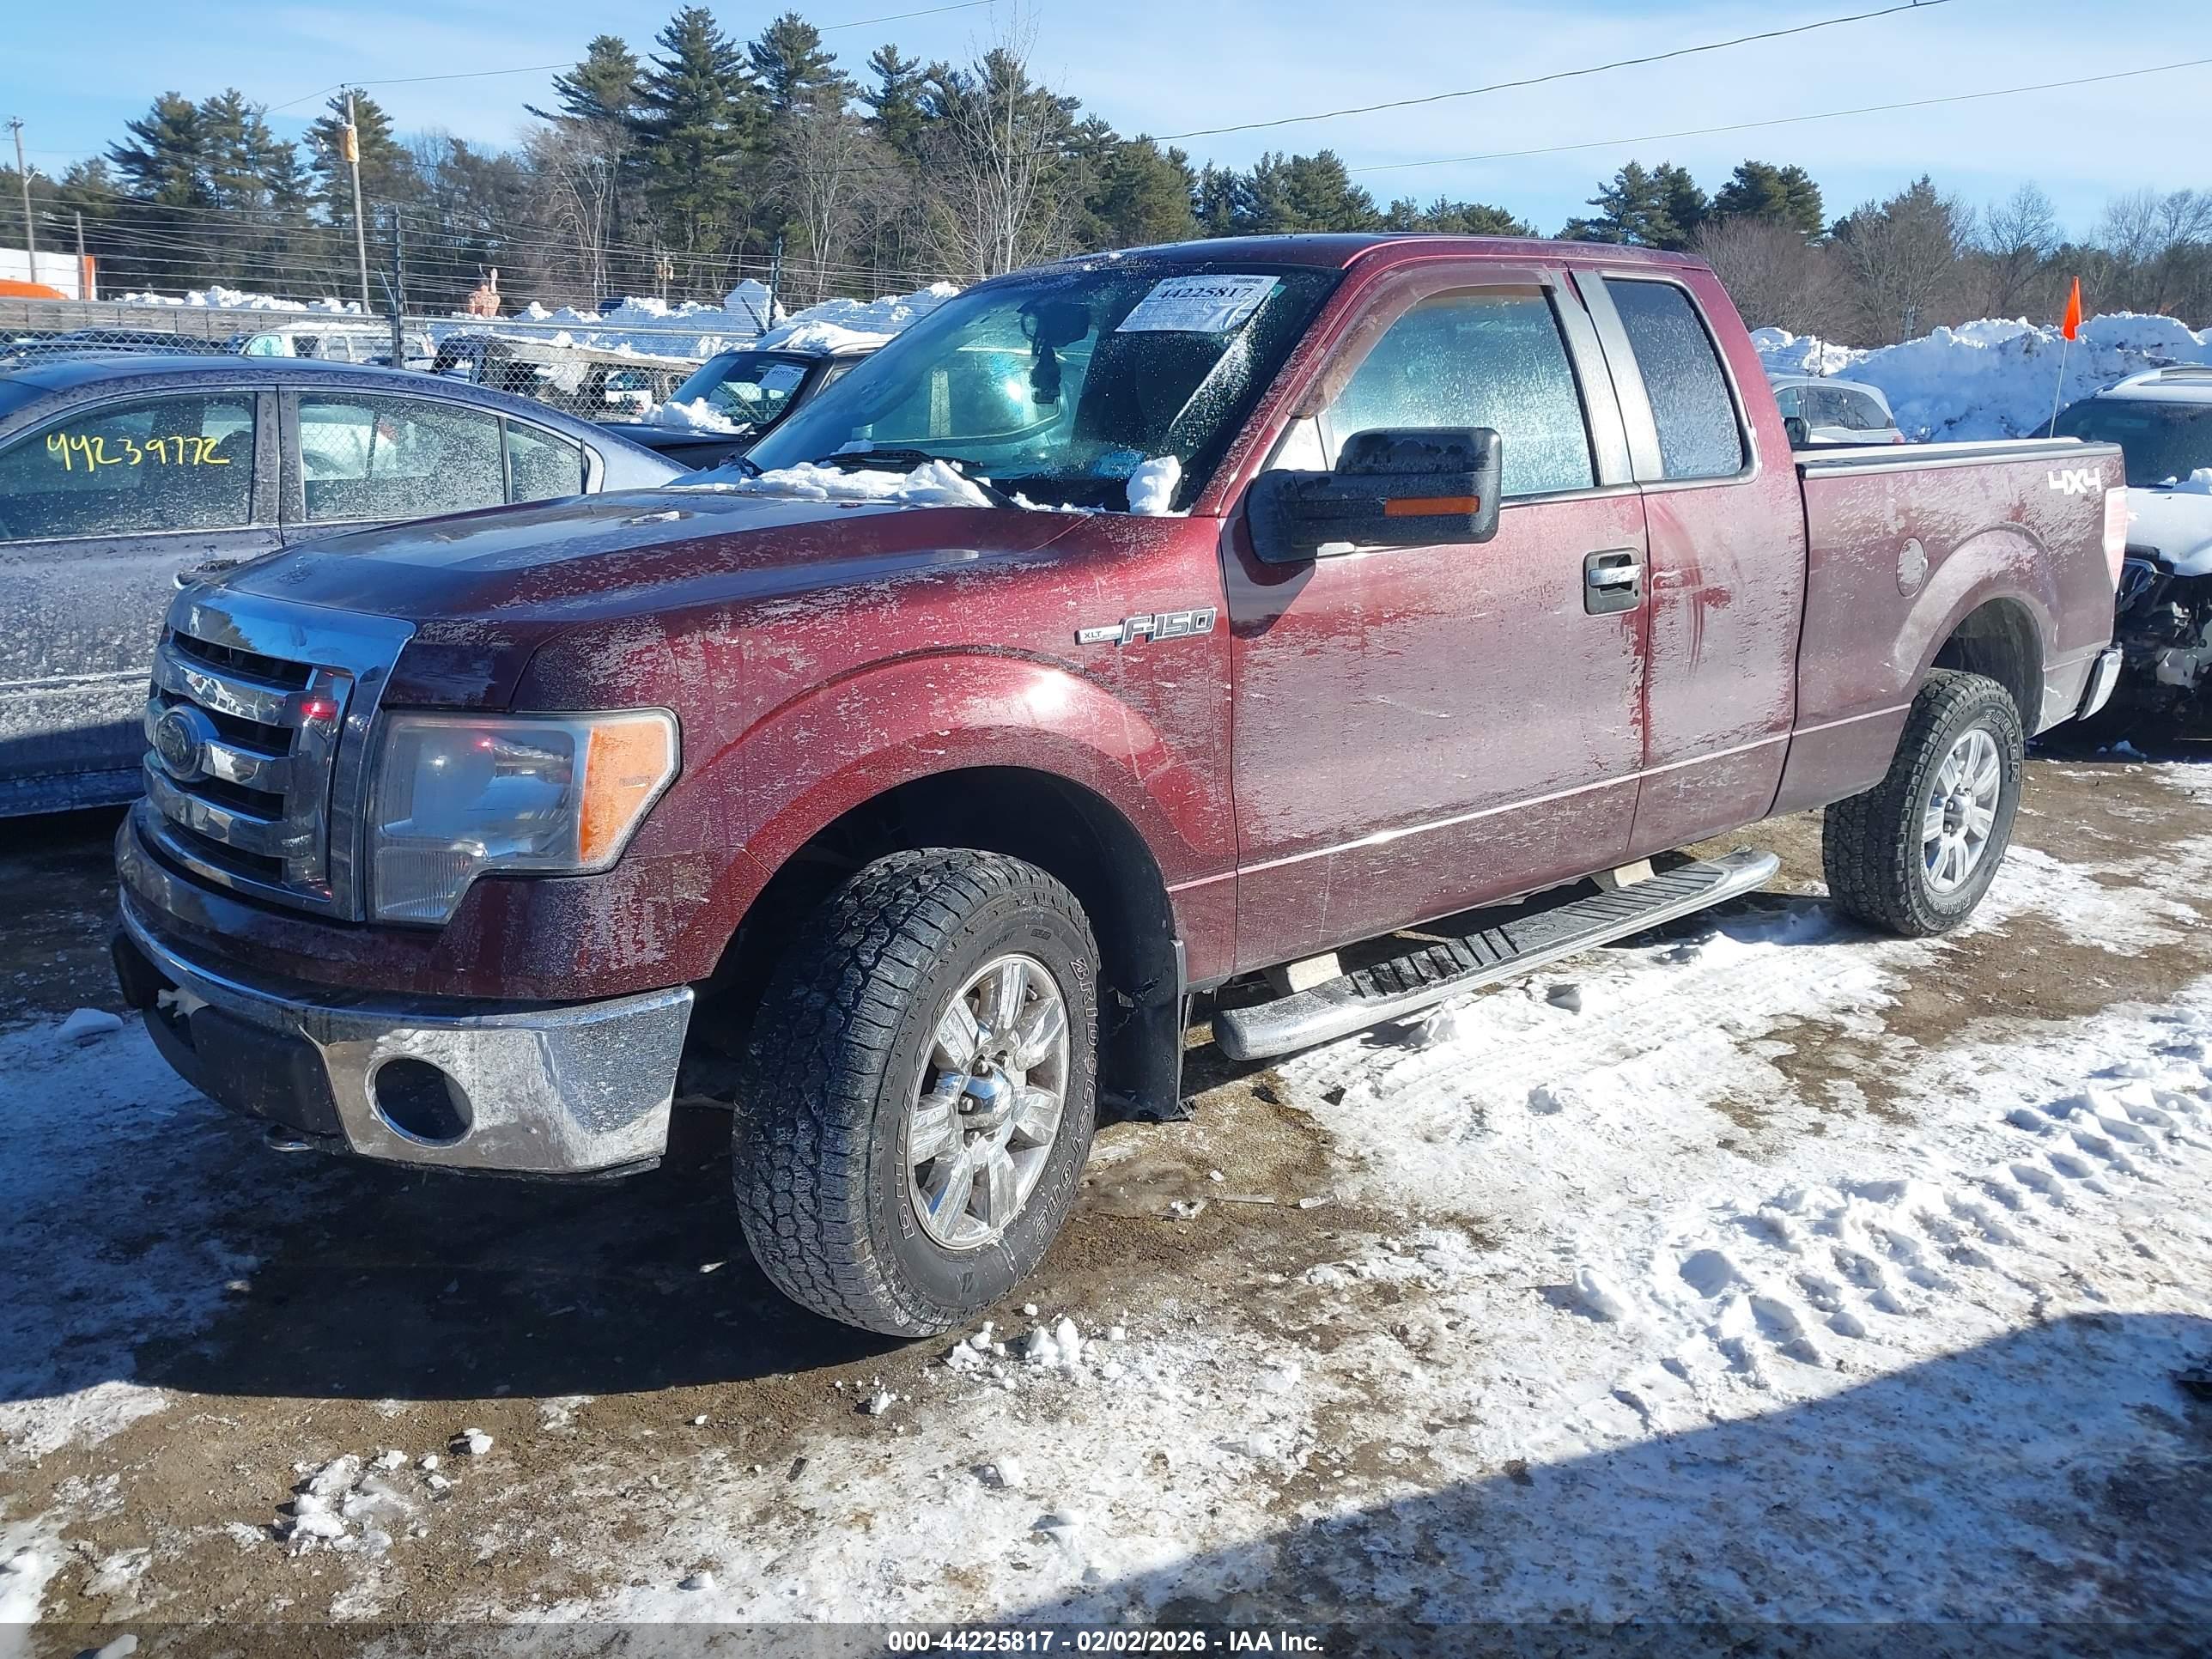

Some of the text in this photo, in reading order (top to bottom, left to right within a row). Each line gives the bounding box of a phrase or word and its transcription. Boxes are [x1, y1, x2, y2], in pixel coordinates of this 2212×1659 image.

[1157, 286, 1255, 300] 44225817
[46, 433, 230, 472] 44239772
[1084, 630, 1103, 640] XLT
[1980, 708, 2020, 783] DUELER
[1034, 956, 1099, 1238] BRIDGESTONE
